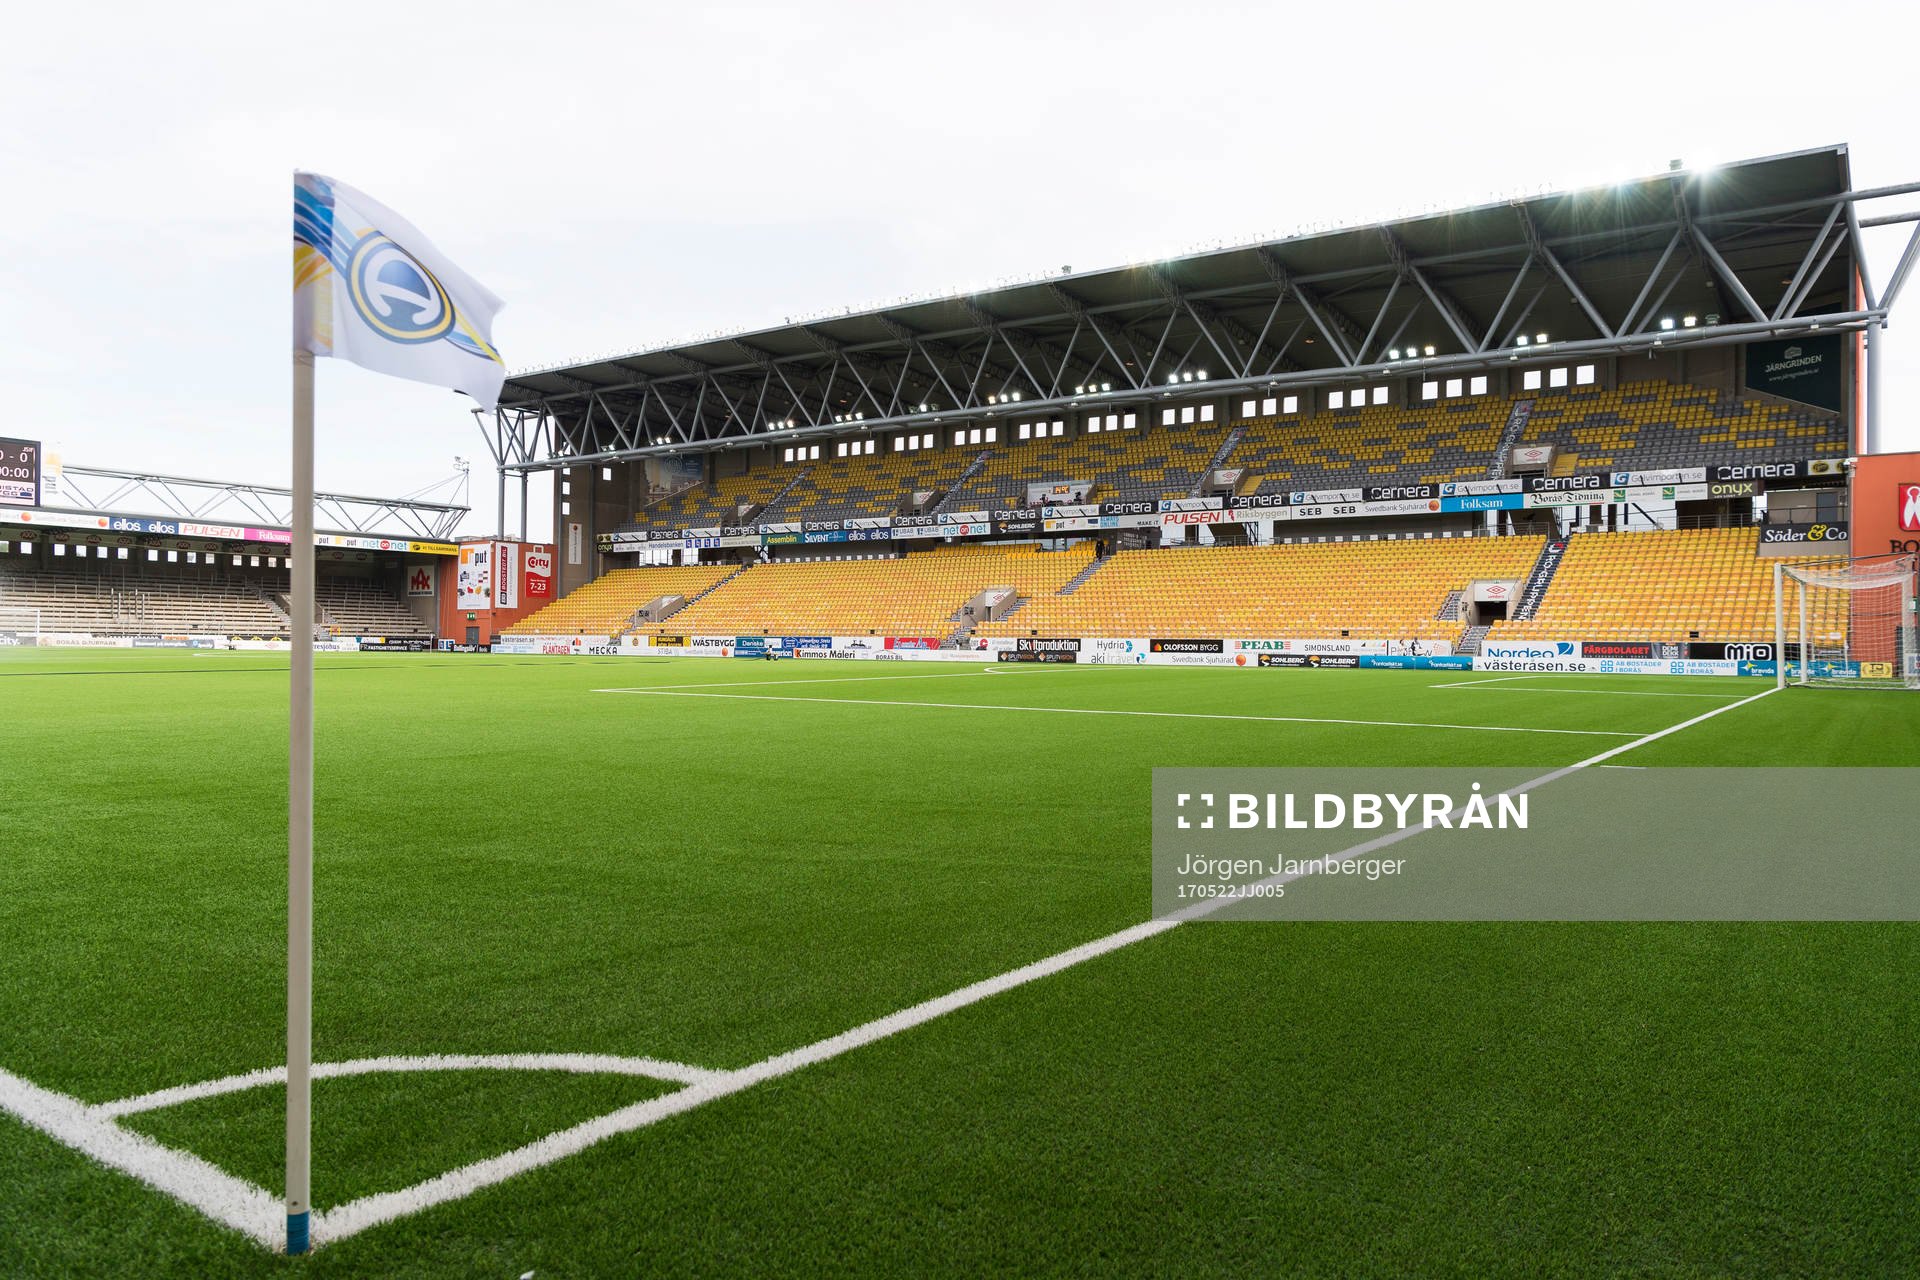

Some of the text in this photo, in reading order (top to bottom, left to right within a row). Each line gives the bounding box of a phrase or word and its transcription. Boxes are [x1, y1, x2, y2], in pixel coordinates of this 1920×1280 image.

[1765, 354, 1822, 373] JÄRNGRINDEN
[20, 452, 28, 462] 0
[0, 466, 29, 478] 0:00
[1717, 463, 1796, 480] Cernera
[1532, 475, 1600, 491] Cernera
[1371, 486, 1429, 500] Cernera
[1711, 483, 1752, 497] onyx
[1230, 494, 1281, 508] Cernera
[1563, 491, 1604, 503] Tidning
[1105, 502, 1152, 514] Cernera
[1365, 502, 1398, 512] Swedbank
[1461, 498, 1503, 509] Folksam
[1236, 509, 1287, 520] Riksbyggen
[1299, 507, 1322, 517] SEB
[1333, 505, 1356, 515] SEB
[1164, 512, 1221, 525] PULSEN
[113, 518, 141, 531] ellos
[148, 521, 175, 534] ellos
[183, 524, 241, 538] PULSEN
[848, 531, 865, 541] ellos
[870, 530, 888, 540] ellos
[944, 526, 959, 536] net
[970, 525, 986, 534] net
[318, 536, 329, 545] put
[346, 538, 357, 547] put
[362, 539, 379, 548] net
[390, 541, 407, 550] net
[767, 535, 797, 543] Assemblin
[648, 541, 683, 549] Handelsbanken
[1890, 540, 1920, 553] BO
[475, 550, 487, 566] put
[528, 556, 549, 568] City
[411, 567, 430, 590] MAX
[530, 582, 546, 590] 7-23
[693, 637, 735, 647] WÄSTBYGG
[1240, 641, 1284, 650] PEAB
[542, 645, 570, 654] PLANTAGEN
[588, 646, 618, 655] MECKA
[797, 649, 827, 658] Kimmos
[829, 649, 855, 658] Måleri
[1304, 644, 1351, 652] SIMONSLAND
[1583, 645, 1649, 654] FÄRGBOLAGET
[1091, 653, 1105, 664] aki
[1171, 656, 1204, 664] Swedbank
